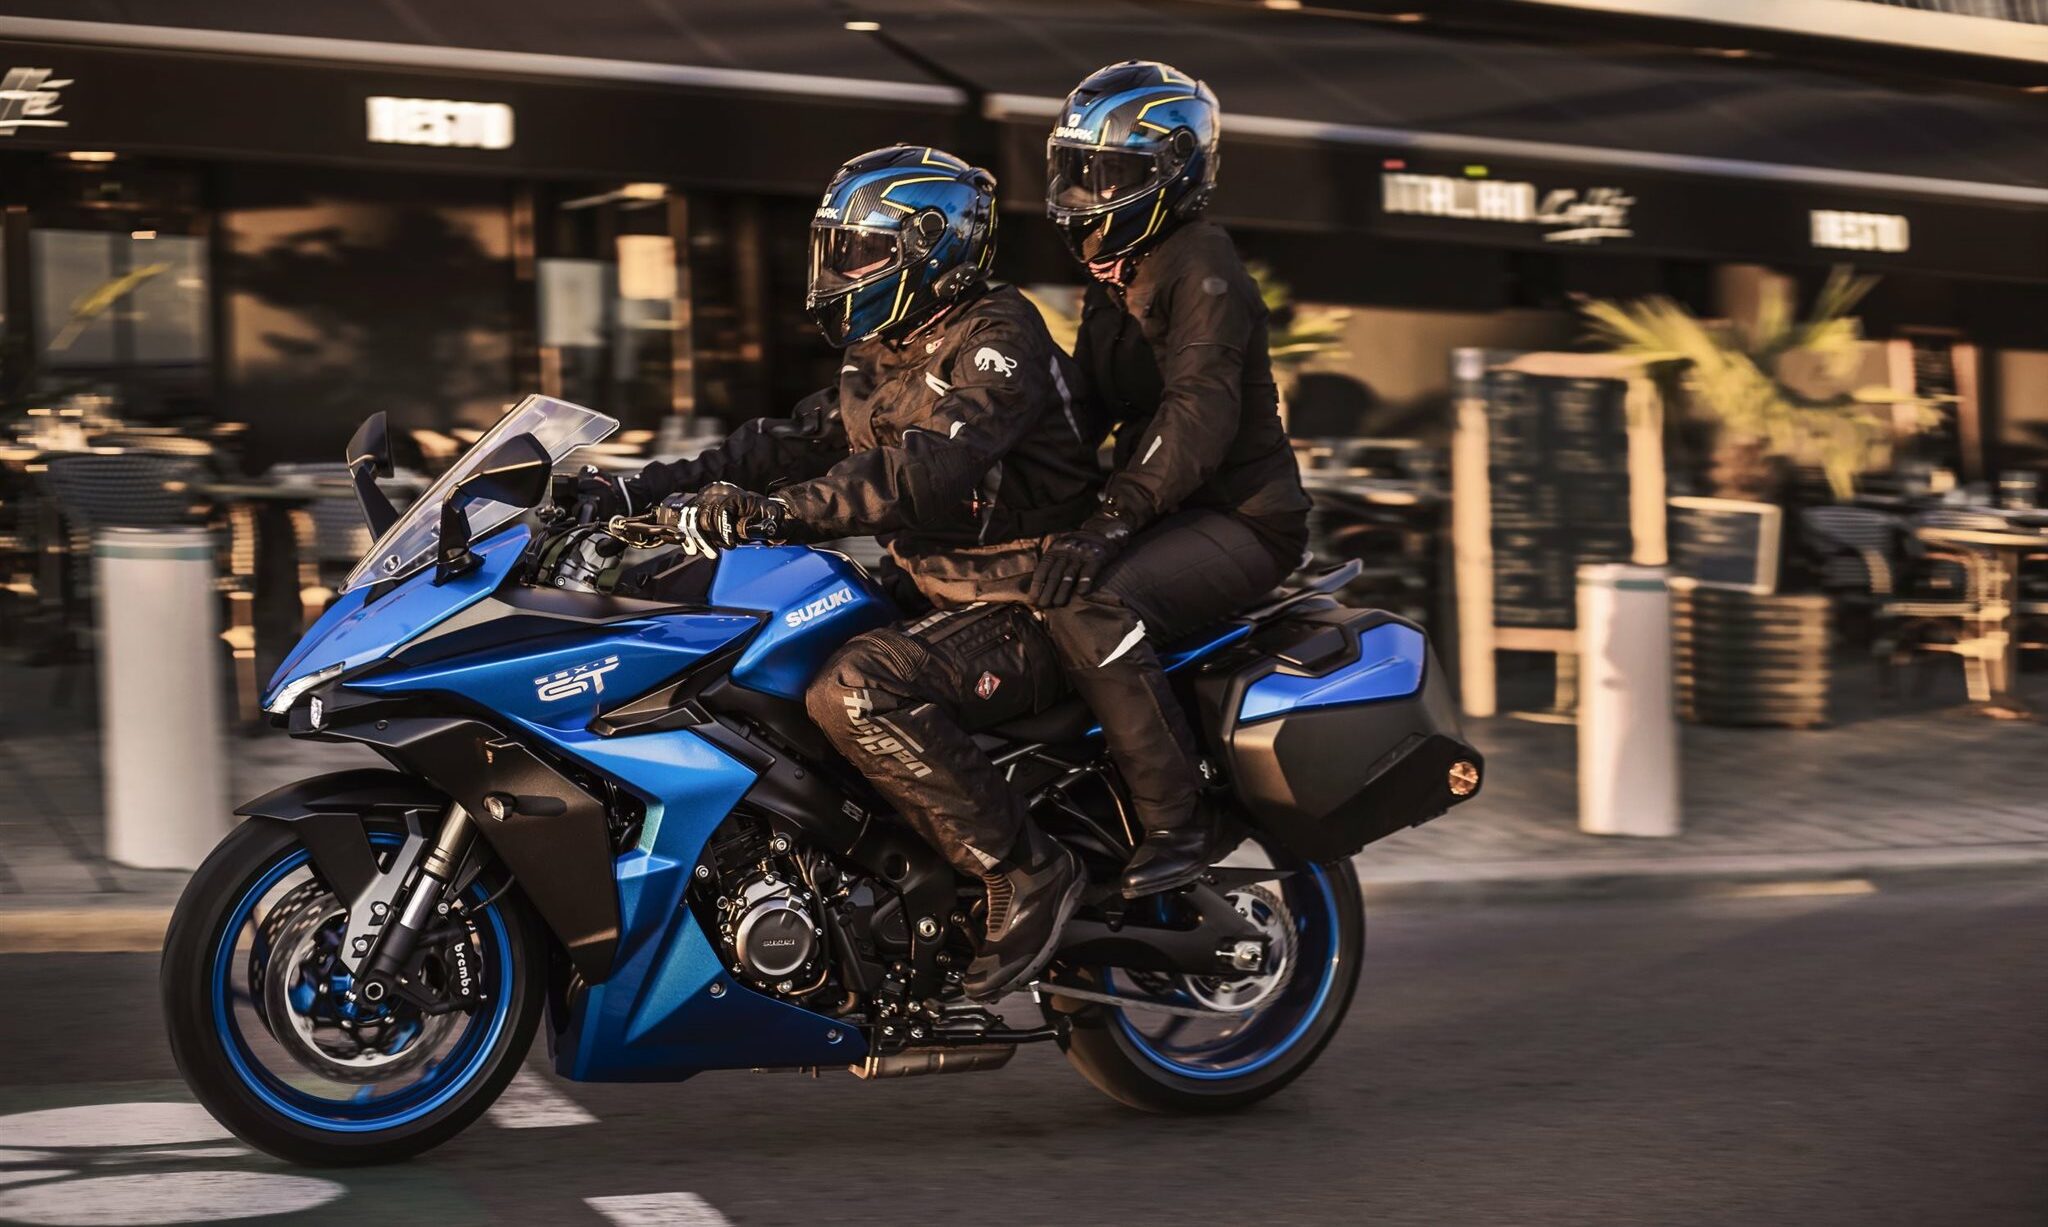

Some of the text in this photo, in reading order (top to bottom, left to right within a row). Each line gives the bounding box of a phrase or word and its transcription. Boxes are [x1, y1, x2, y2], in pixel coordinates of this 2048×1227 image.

[1055, 126, 1095, 142] SHARK
[814, 207, 840, 220] HARK
[785, 587, 853, 628] SUZUKI
[537, 662, 619, 702] GT
[454, 942, 472, 996] brembo
